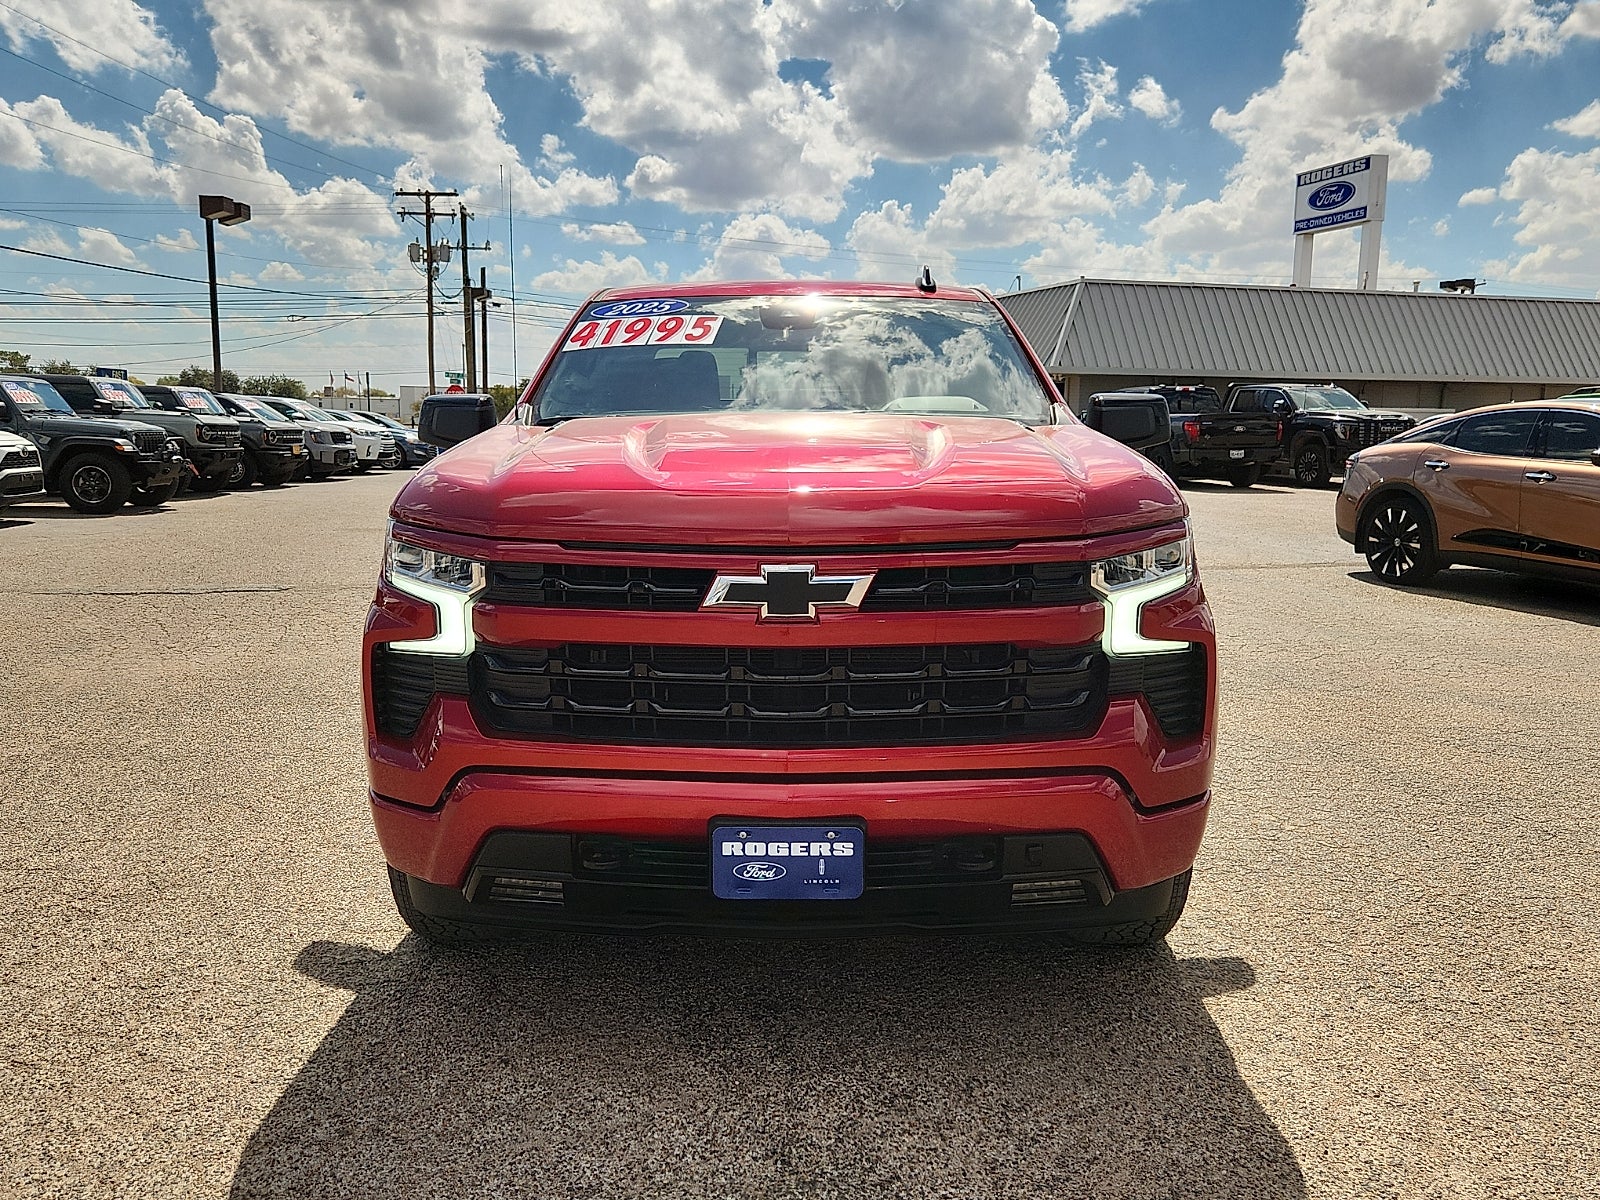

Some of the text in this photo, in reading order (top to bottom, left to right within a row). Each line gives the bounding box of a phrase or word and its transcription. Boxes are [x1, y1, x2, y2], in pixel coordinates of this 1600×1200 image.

[1300, 160, 1366, 185] ROGERS
[1316, 186, 1345, 207] Ford
[1296, 209, 1365, 230] PRE-OWNED VEHICLES
[605, 301, 677, 316] 2025
[569, 316, 719, 347] 41995
[721, 841, 854, 857] ROGERS
[743, 864, 777, 879] Ford
